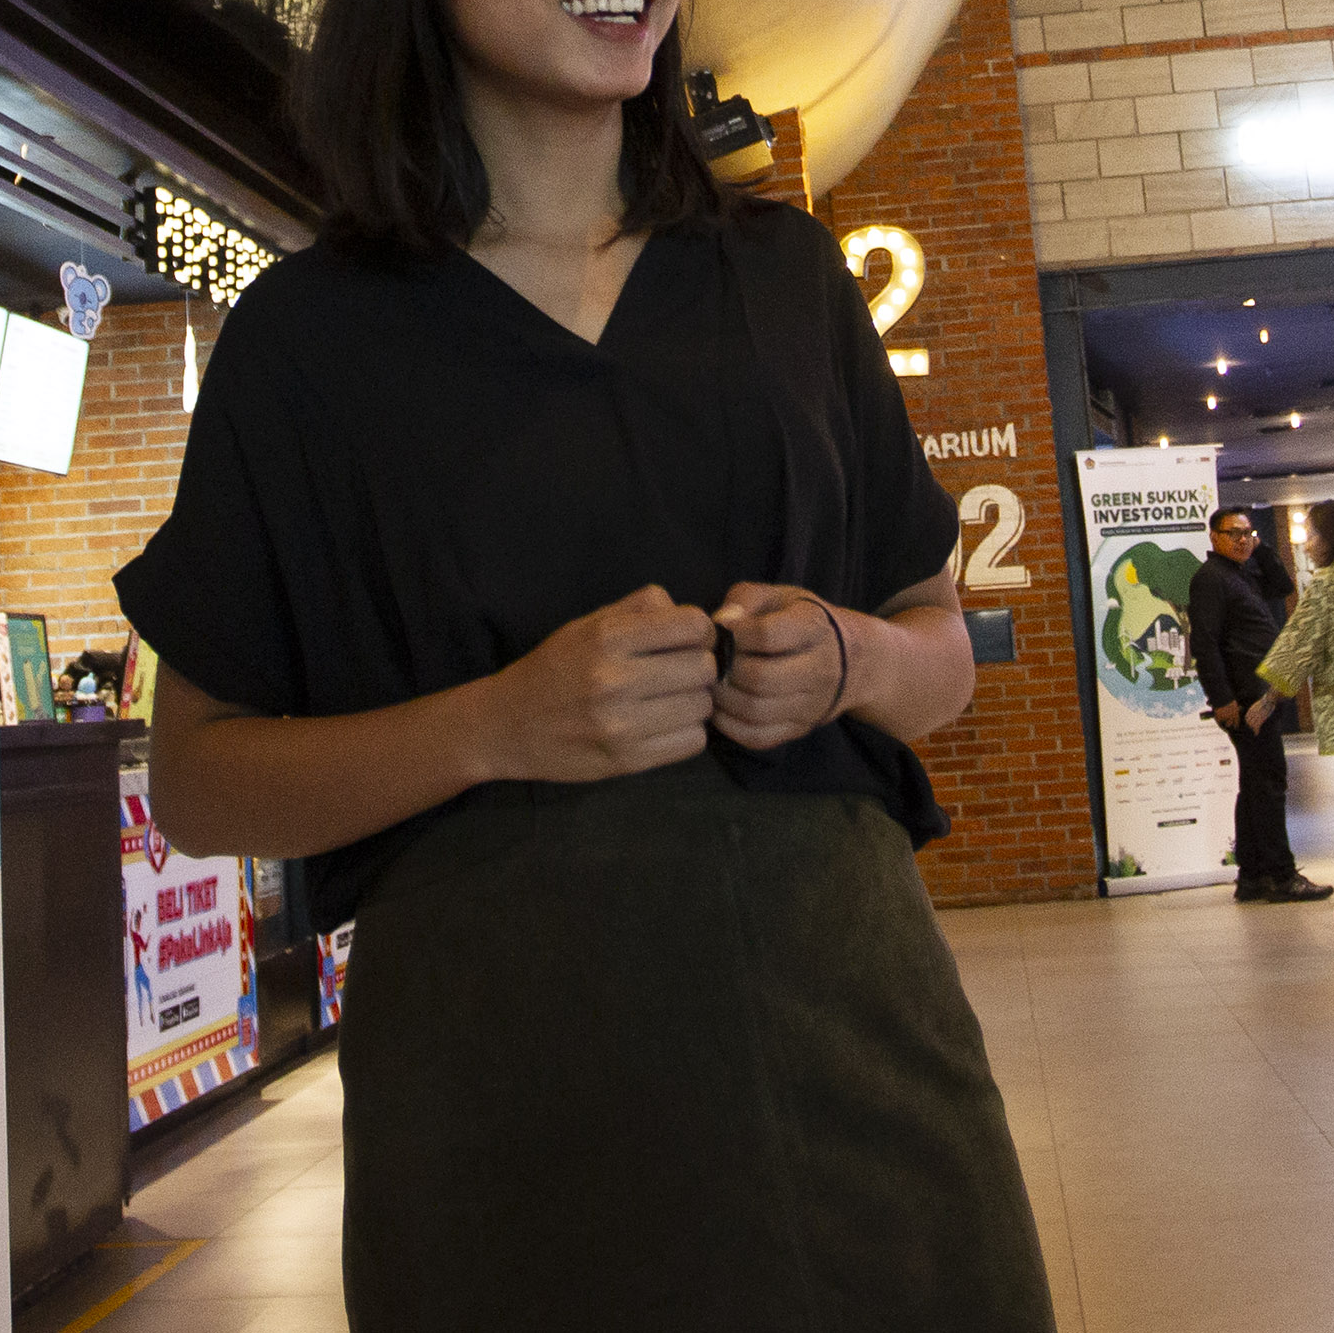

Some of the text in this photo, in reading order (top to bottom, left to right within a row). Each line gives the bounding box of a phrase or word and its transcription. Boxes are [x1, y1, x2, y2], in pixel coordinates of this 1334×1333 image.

[840, 224, 930, 378] 2
[917, 422, 1018, 459] ARIUM
[1091, 489, 1199, 508] GREEN SUKUK
[948, 484, 1031, 591] 2
[157, 875, 219, 927] BELI TIKET
